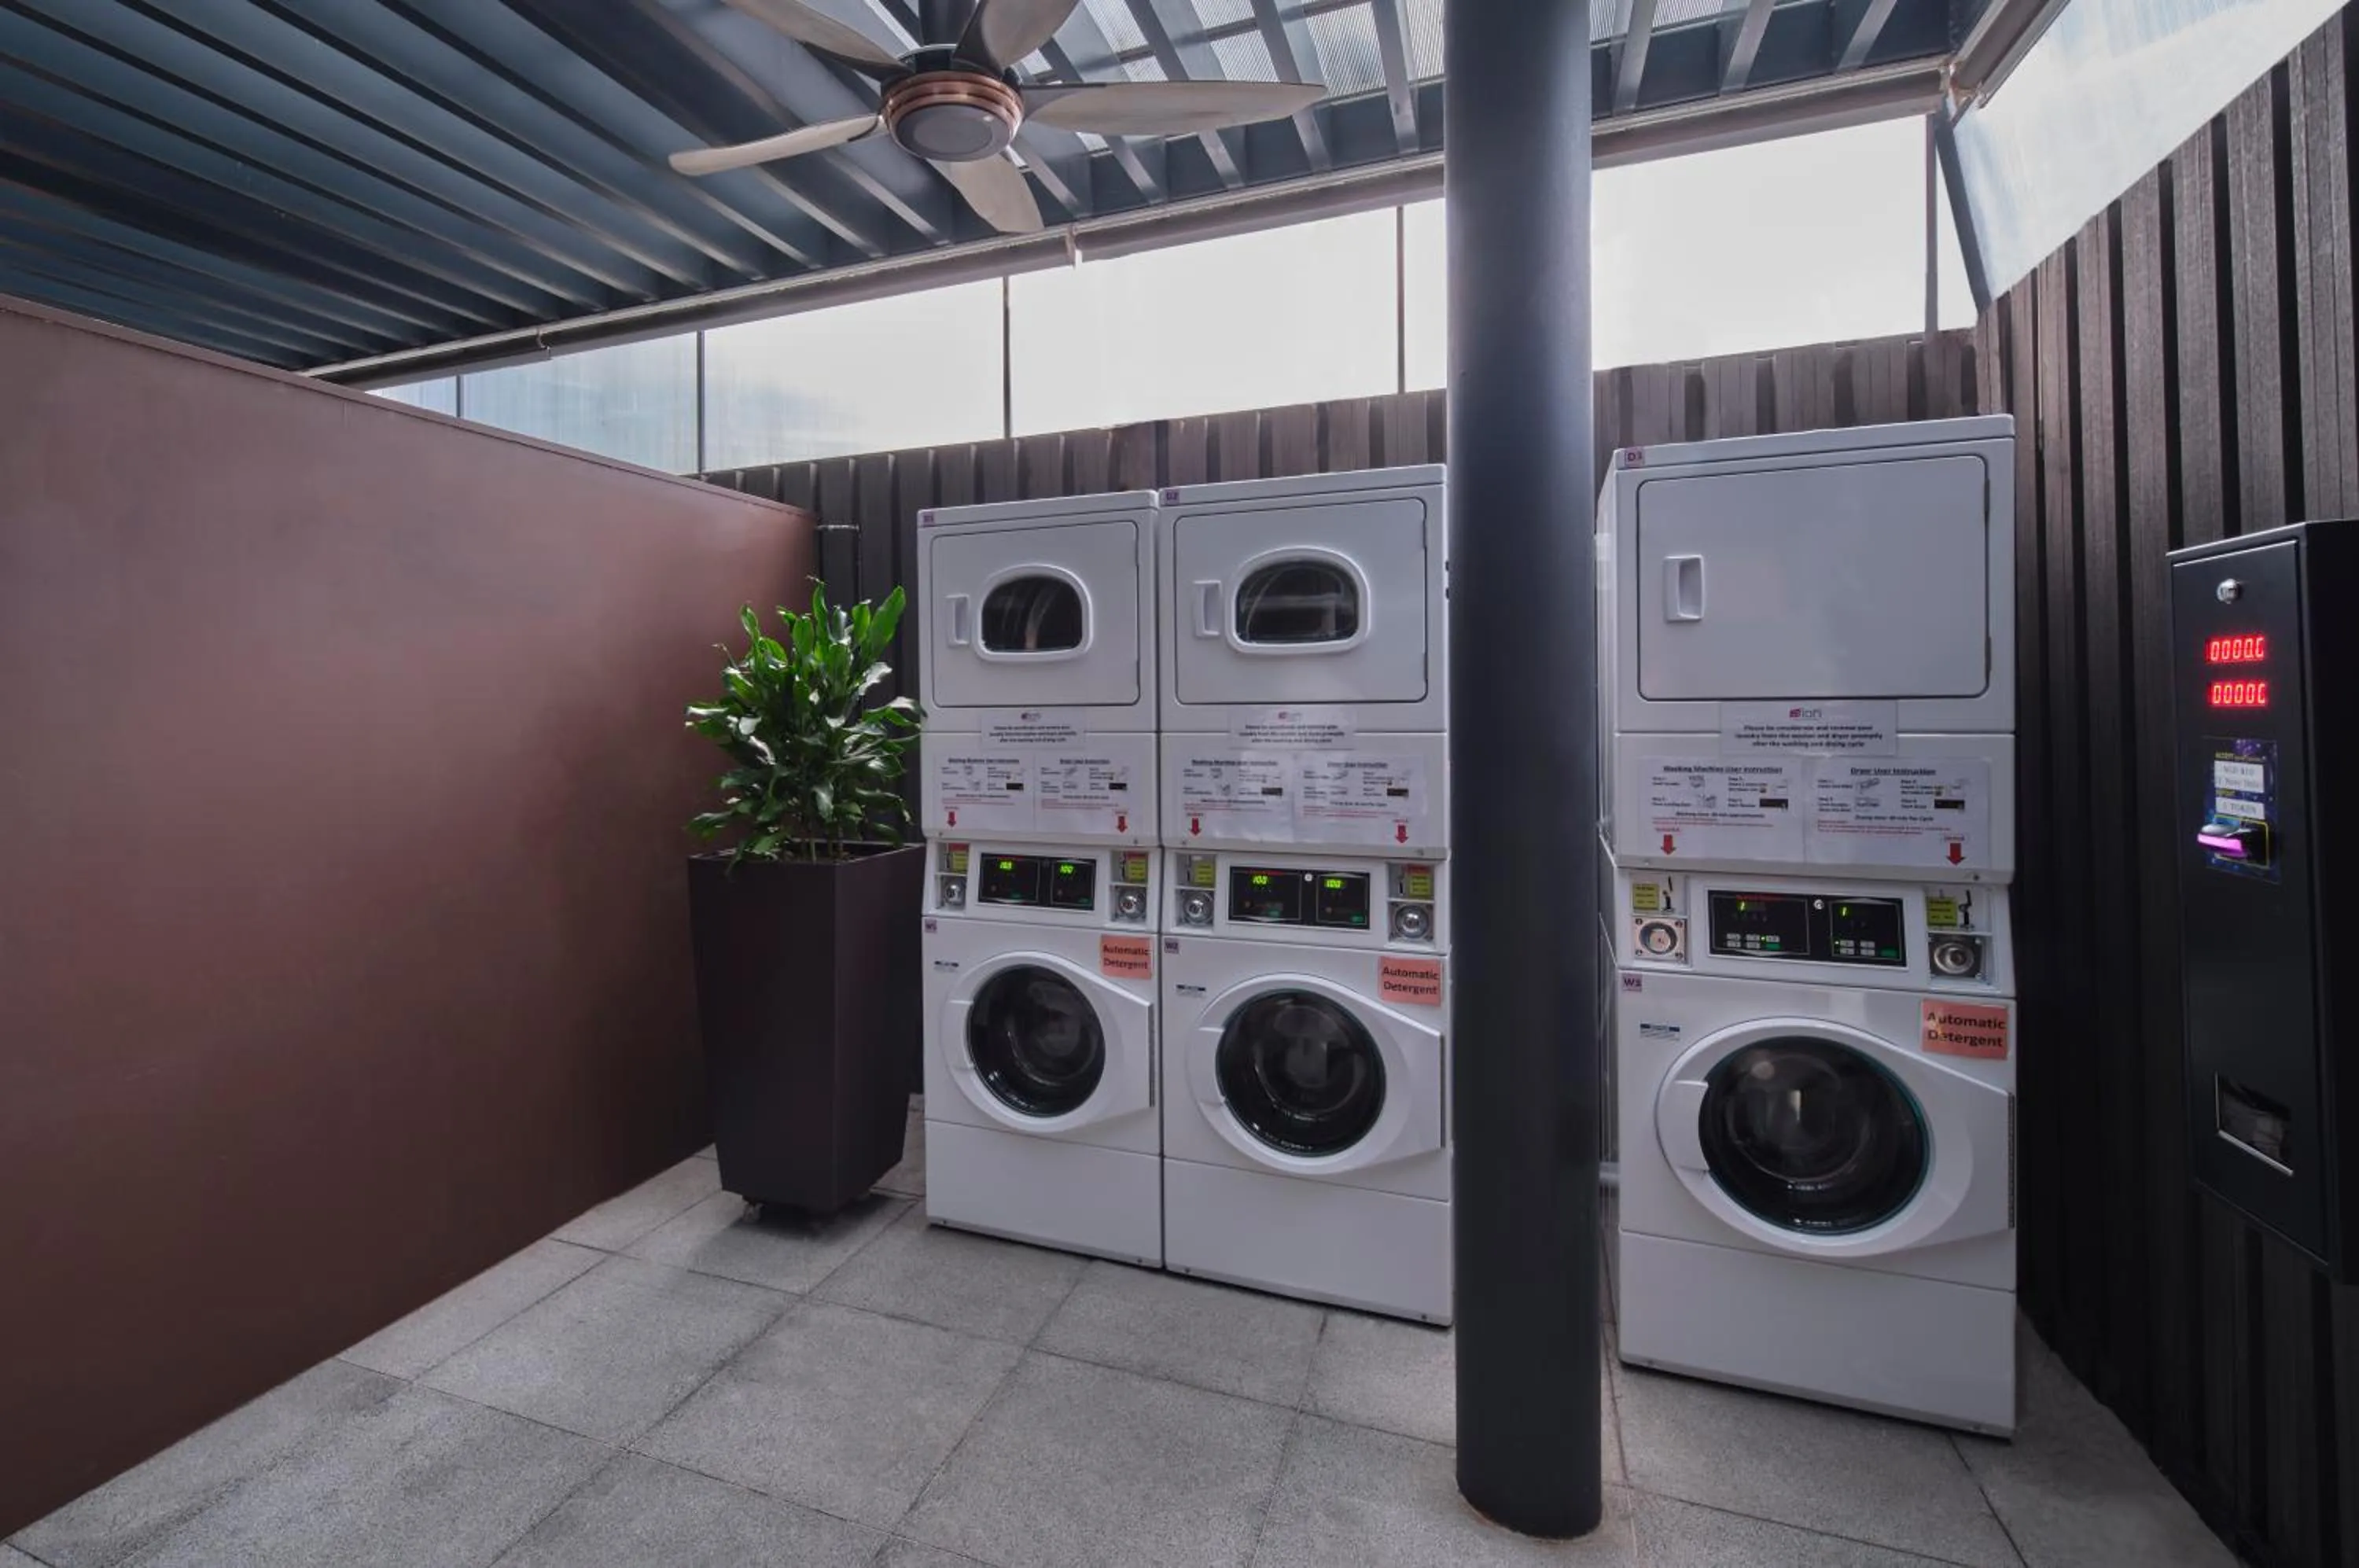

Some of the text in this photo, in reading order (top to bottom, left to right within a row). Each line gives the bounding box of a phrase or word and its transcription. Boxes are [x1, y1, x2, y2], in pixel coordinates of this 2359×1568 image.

[1102, 944, 1150, 957] Automatic
[1103, 957, 1148, 970] Detergent
[1382, 965, 1440, 981] Automatic
[1383, 980, 1438, 996] Detergent
[1927, 1011, 2006, 1030] Automatic
[1928, 1029, 2004, 1048] Detergent
